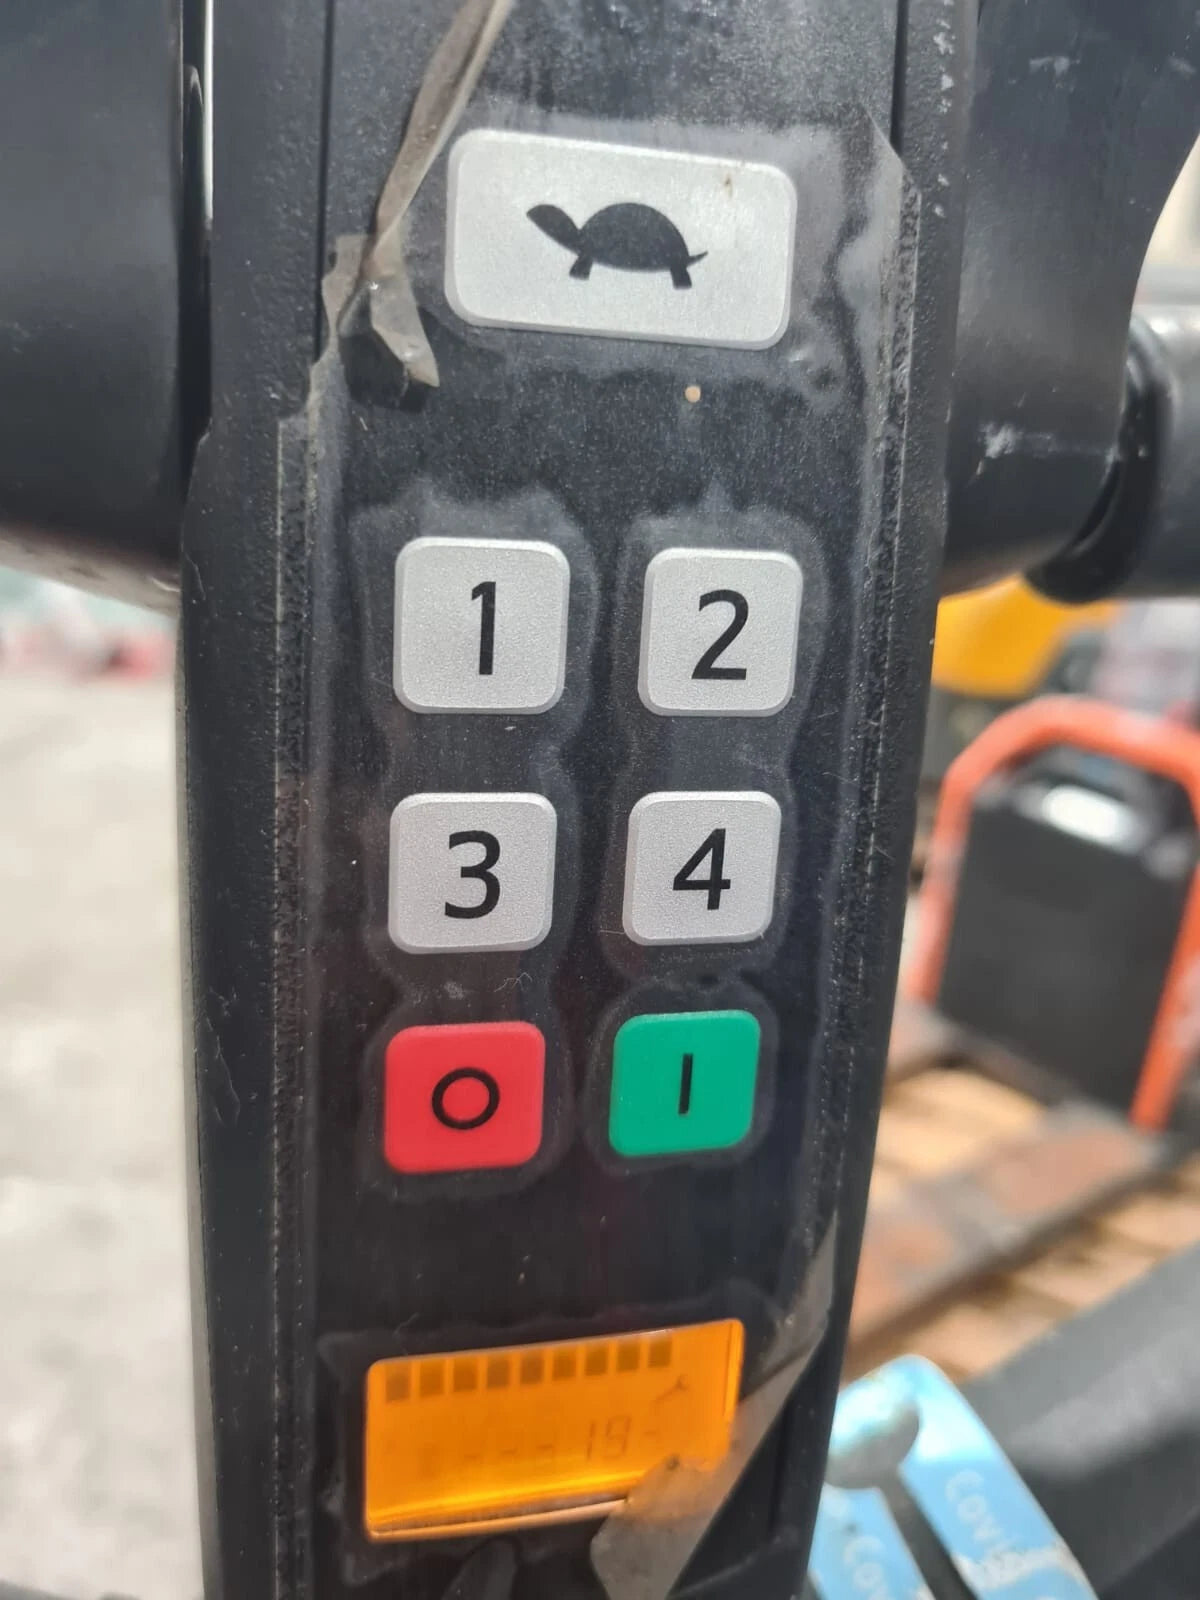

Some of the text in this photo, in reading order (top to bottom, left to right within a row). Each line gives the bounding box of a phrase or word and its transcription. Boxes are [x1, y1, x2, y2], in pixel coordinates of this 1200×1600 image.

[471, 581, 497, 675] 1
[691, 589, 749, 680] 2
[444, 829, 501, 919] 3
[672, 828, 731, 911] 4
